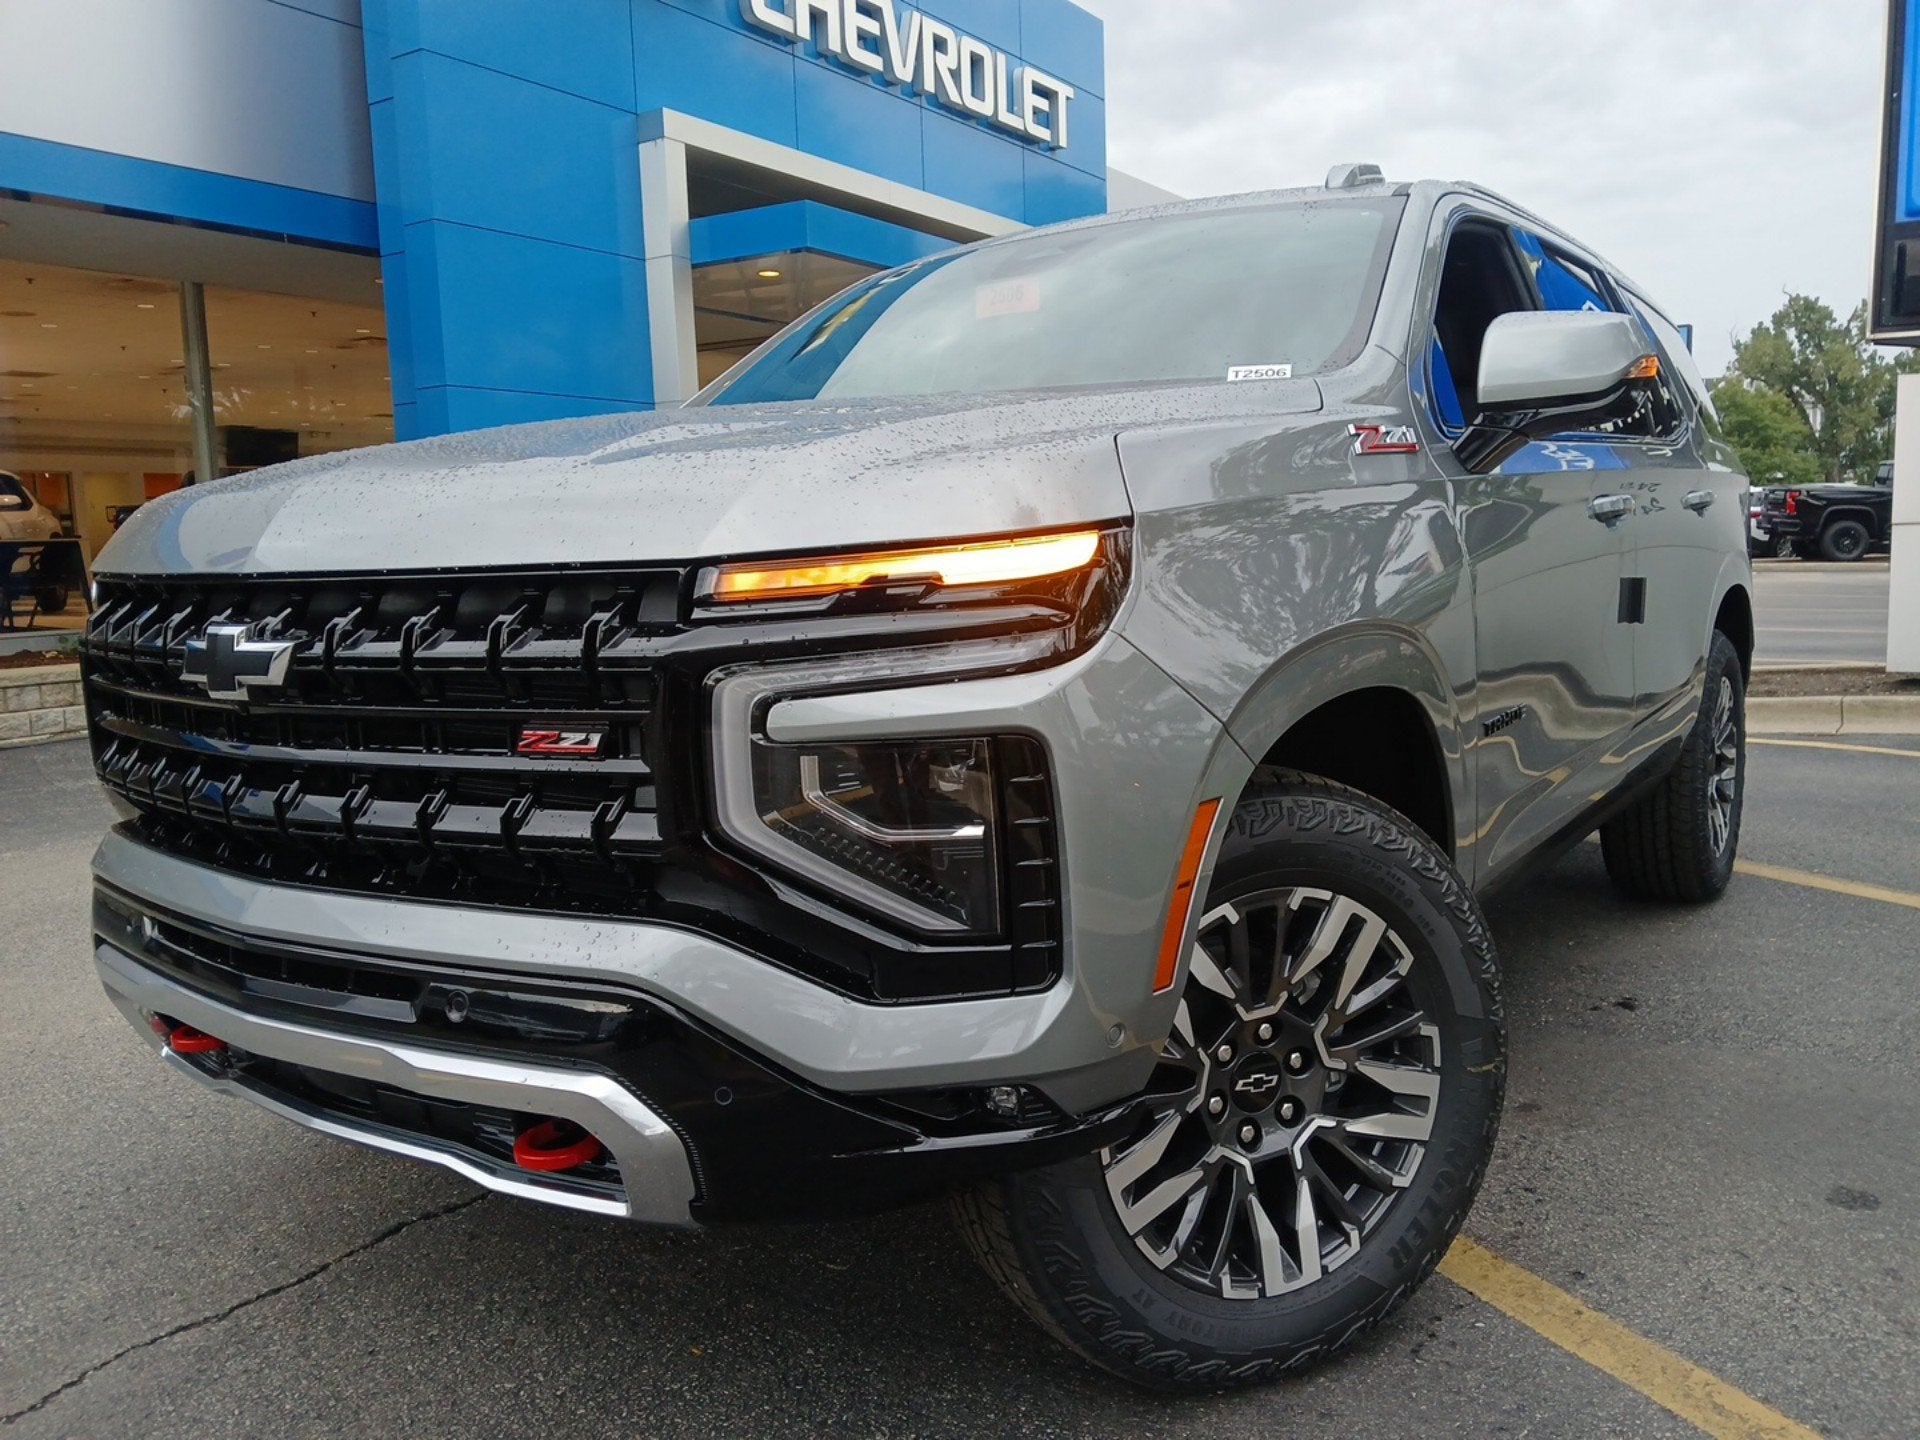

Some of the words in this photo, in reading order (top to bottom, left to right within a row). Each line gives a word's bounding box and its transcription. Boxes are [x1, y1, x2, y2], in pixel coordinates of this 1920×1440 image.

[1231, 367, 1288, 379] T2506
[1346, 423, 1420, 455] Z71
[518, 730, 602, 753] Z71
